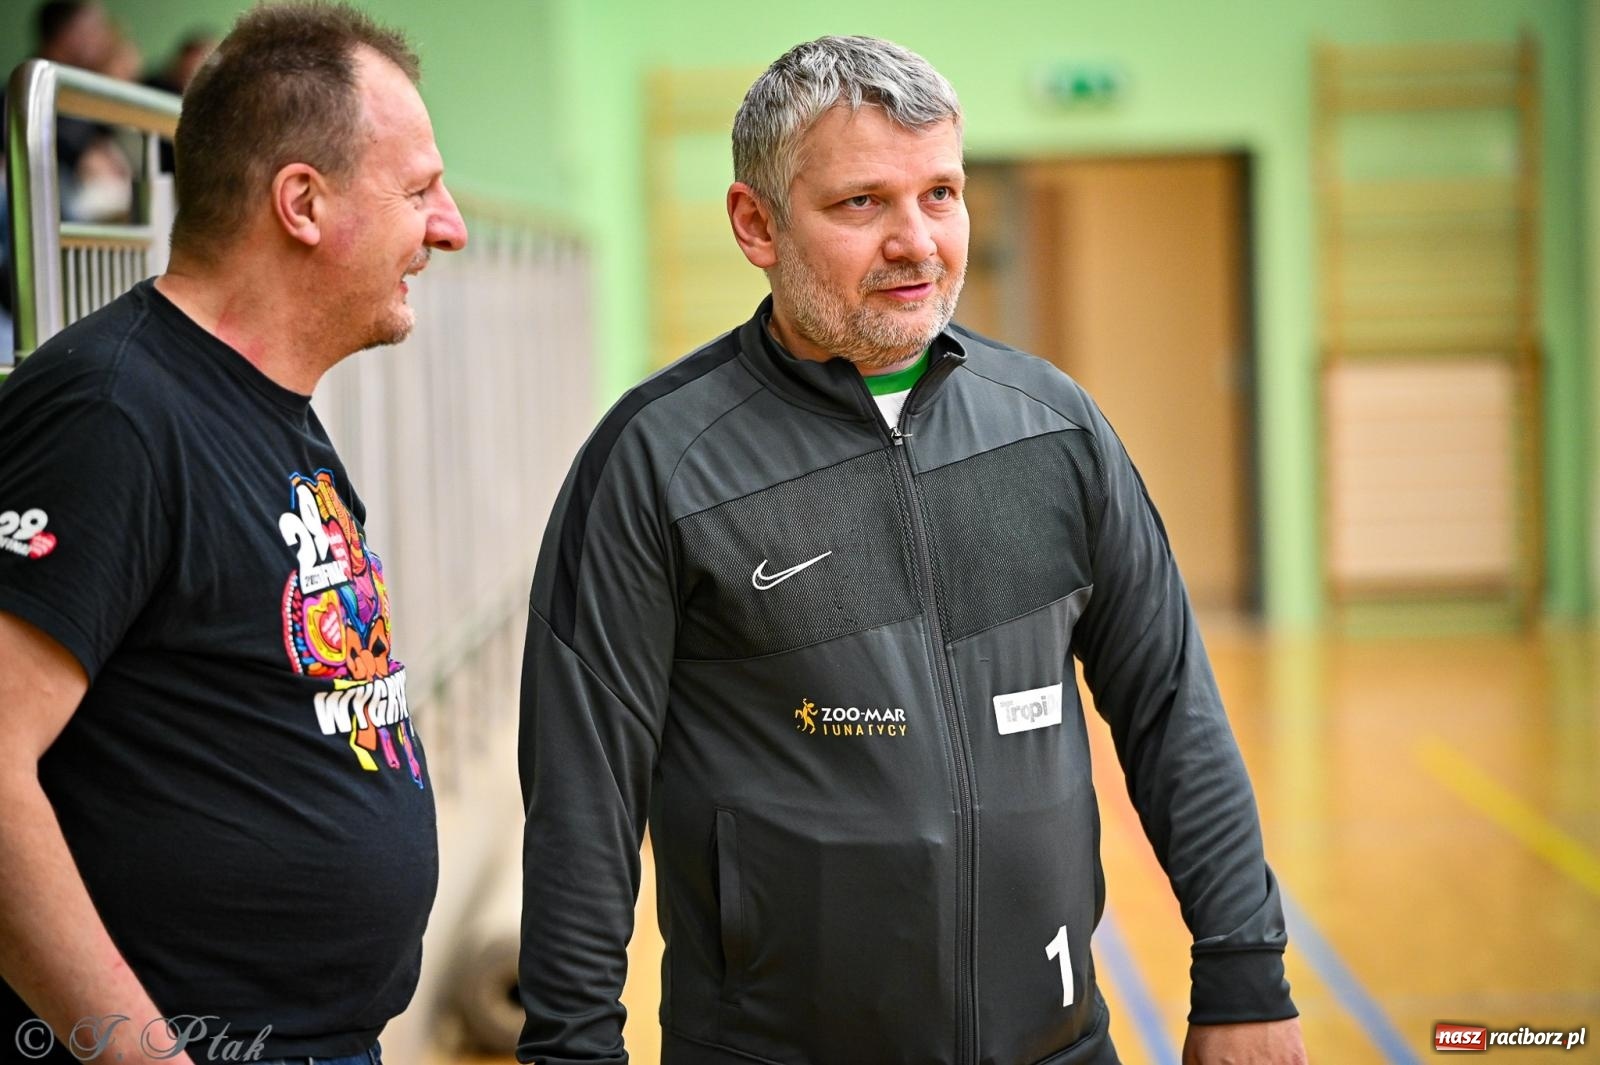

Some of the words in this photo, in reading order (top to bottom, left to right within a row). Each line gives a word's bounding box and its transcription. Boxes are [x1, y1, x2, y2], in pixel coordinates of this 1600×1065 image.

[0, 508, 48, 548] 29
[821, 707, 906, 722] ZOO-MAR
[1000, 695, 1056, 723] Tropi
[1045, 925, 1074, 1007] 1
